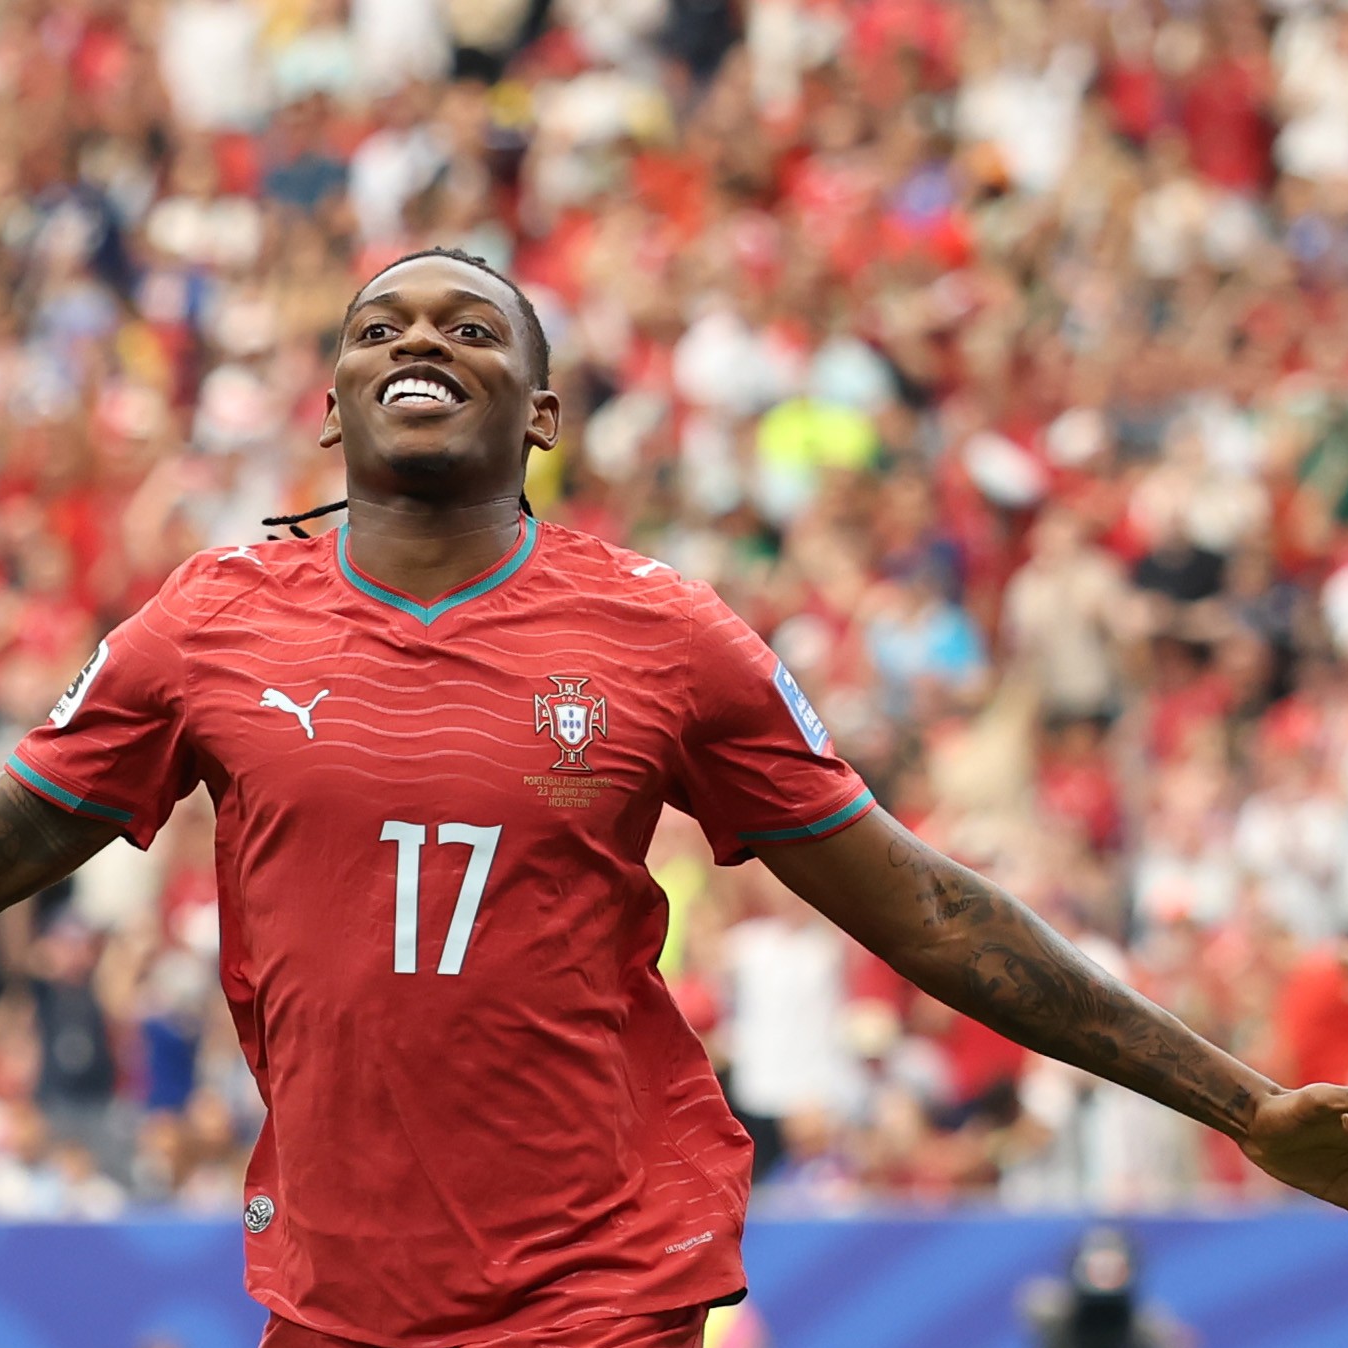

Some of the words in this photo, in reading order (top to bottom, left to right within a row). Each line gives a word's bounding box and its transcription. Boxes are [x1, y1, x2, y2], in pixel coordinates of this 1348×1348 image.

[537, 786, 549, 796] 23
[548, 797, 591, 808] HOUSTON
[379, 820, 503, 976] 17
